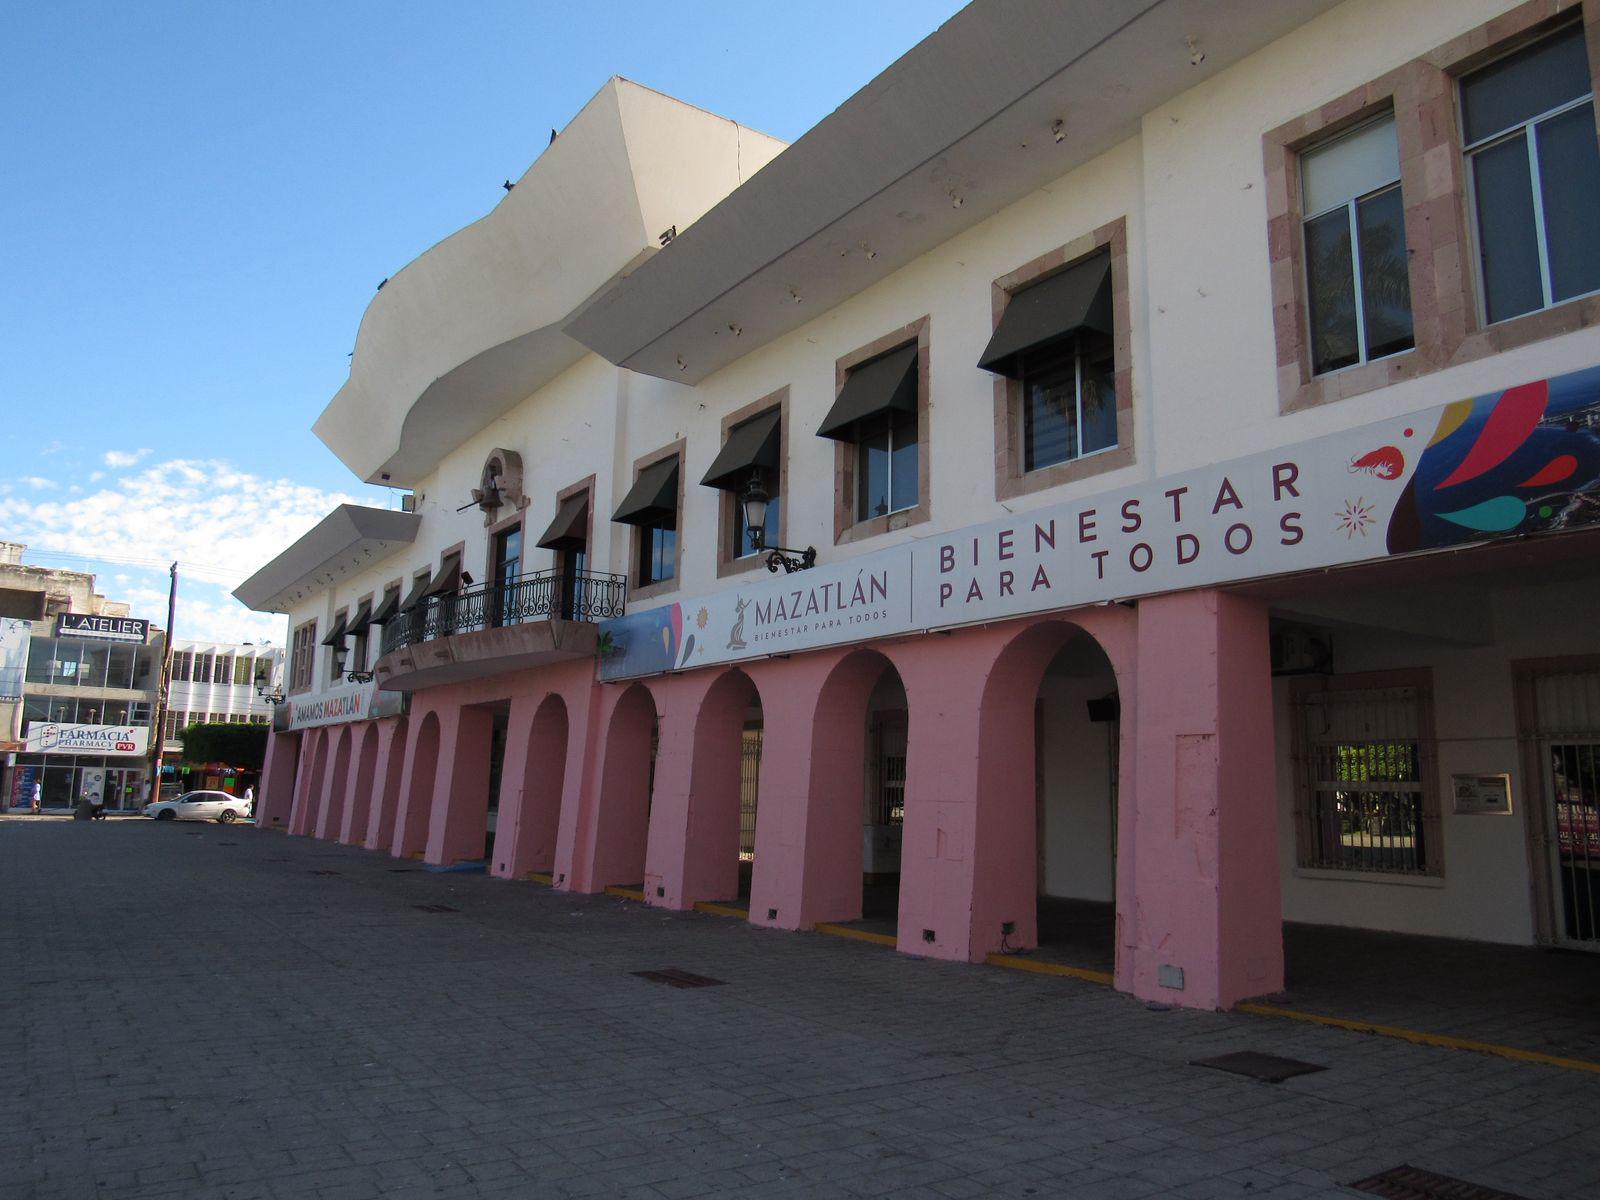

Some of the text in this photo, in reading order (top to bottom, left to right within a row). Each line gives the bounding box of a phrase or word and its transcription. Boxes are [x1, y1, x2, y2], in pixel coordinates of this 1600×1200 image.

[939, 461, 1301, 574] BIENESTAR
[939, 511, 1304, 609] PARA TODOS
[755, 568, 888, 627] MAZATLÁN
[754, 610, 888, 642] BIENESTAR PARA TODOS
[58, 739, 114, 748] PHARMACY
[60, 729, 129, 741] FARMACIA
[116, 742, 134, 750] PVR
